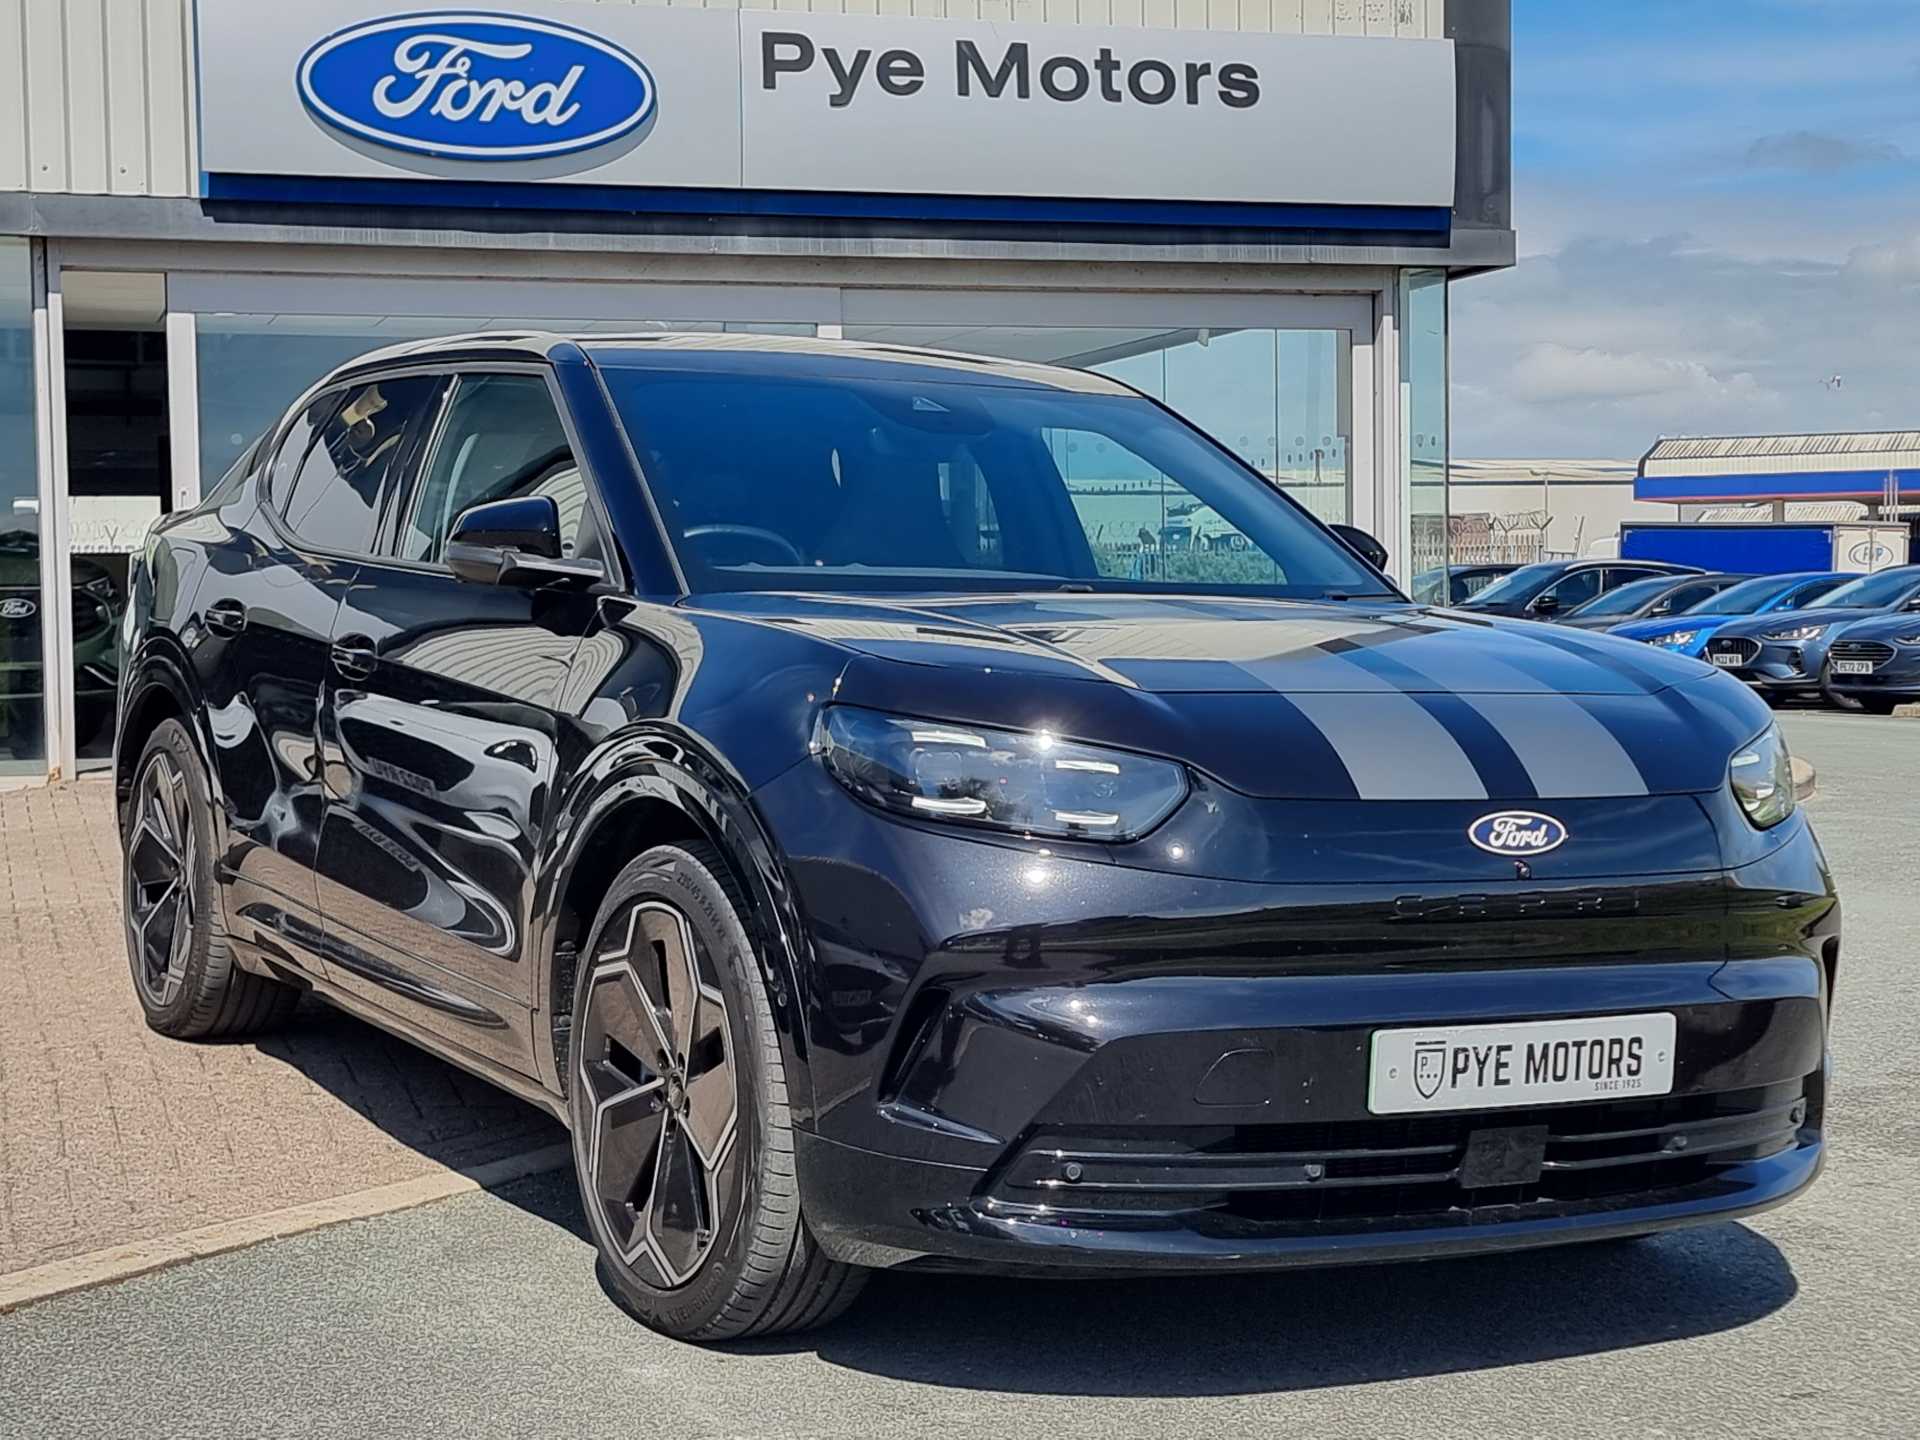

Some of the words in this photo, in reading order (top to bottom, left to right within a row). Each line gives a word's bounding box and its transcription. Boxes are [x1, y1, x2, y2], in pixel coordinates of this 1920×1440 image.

[372, 34, 585, 126] Ford
[760, 30, 925, 107] Pye
[955, 39, 1261, 108] Motors
[1488, 817, 1549, 848] Ford
[1450, 1044, 1514, 1089] PYE
[1524, 1036, 1644, 1085] MOTORS
[1593, 1080, 1619, 1092] SINCE
